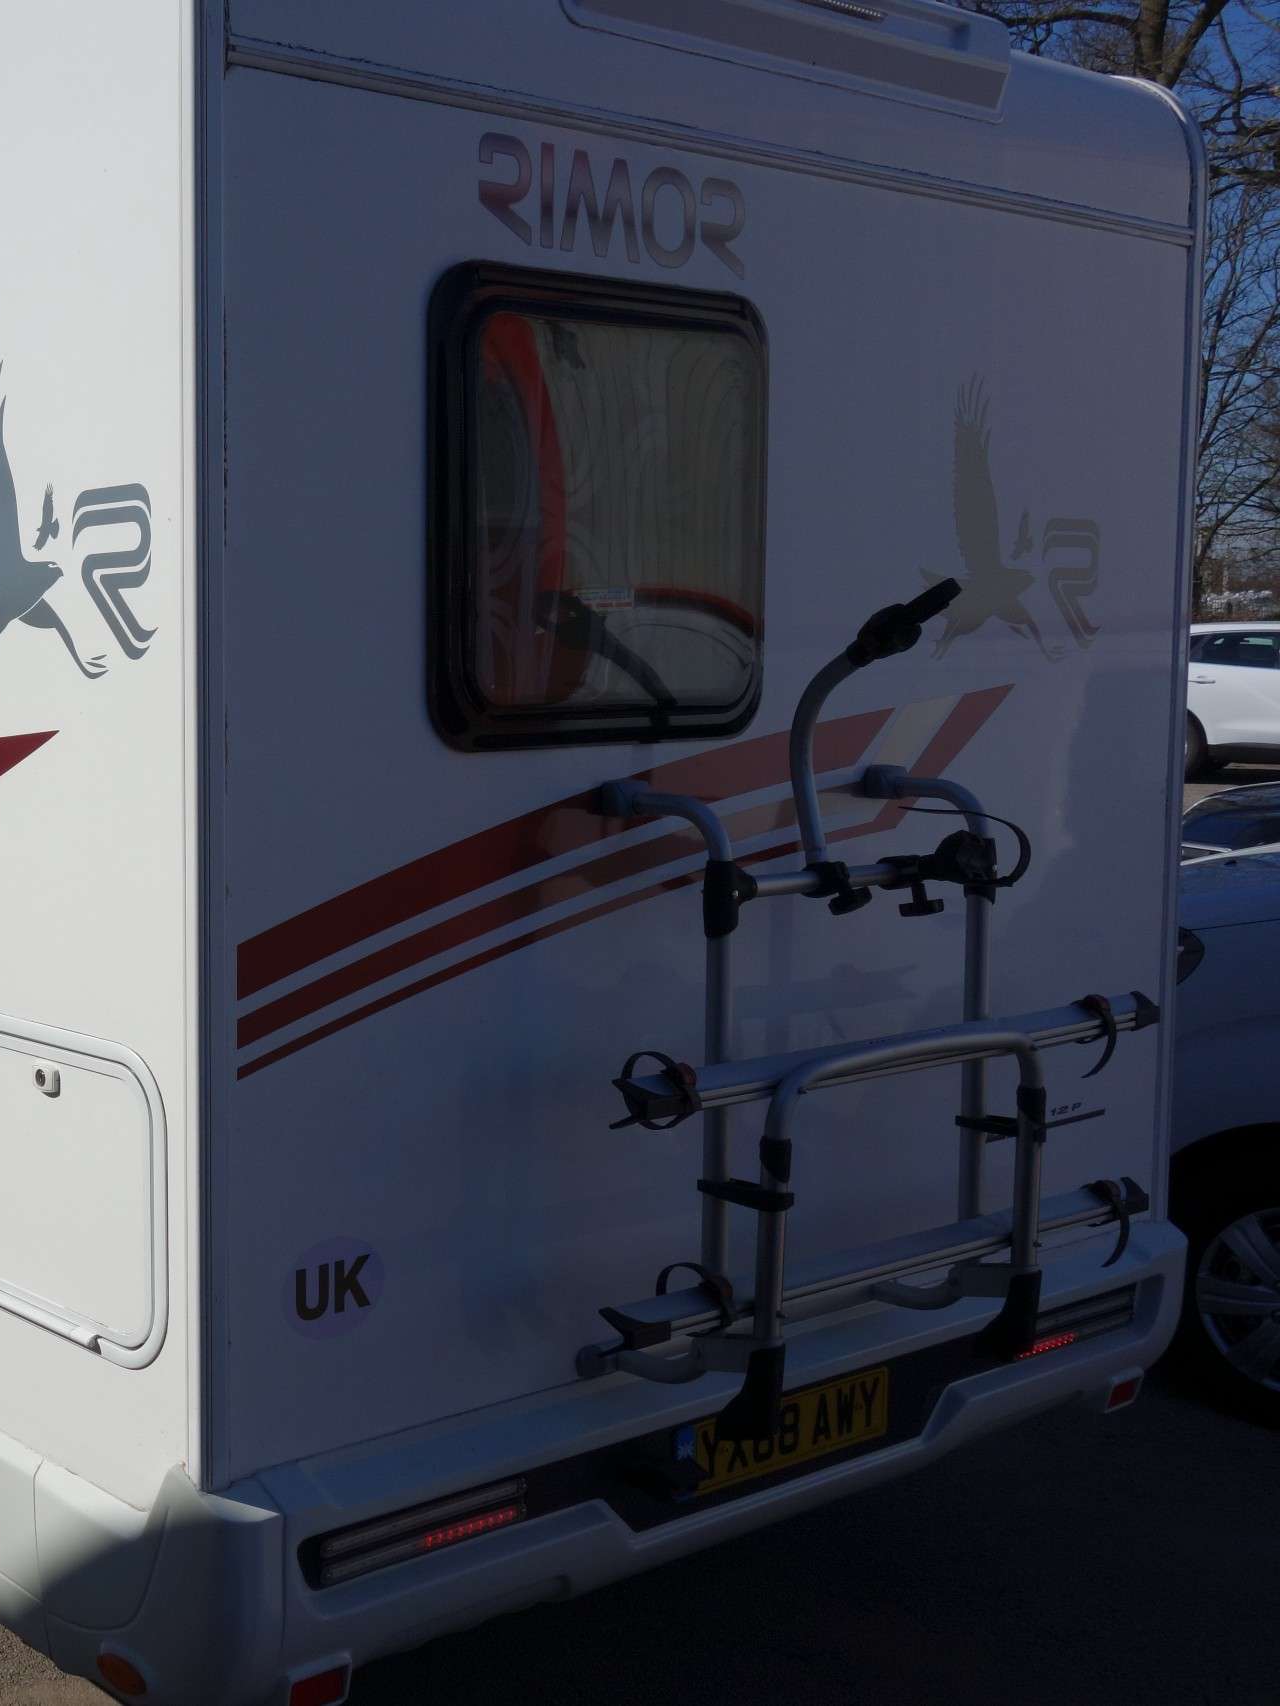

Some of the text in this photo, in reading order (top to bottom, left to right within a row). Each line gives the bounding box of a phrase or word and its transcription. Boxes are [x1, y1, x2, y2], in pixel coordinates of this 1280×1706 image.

[478, 131, 747, 280] RIMOR
[295, 1252, 372, 1322] UK
[812, 1375, 881, 1447] AWY
